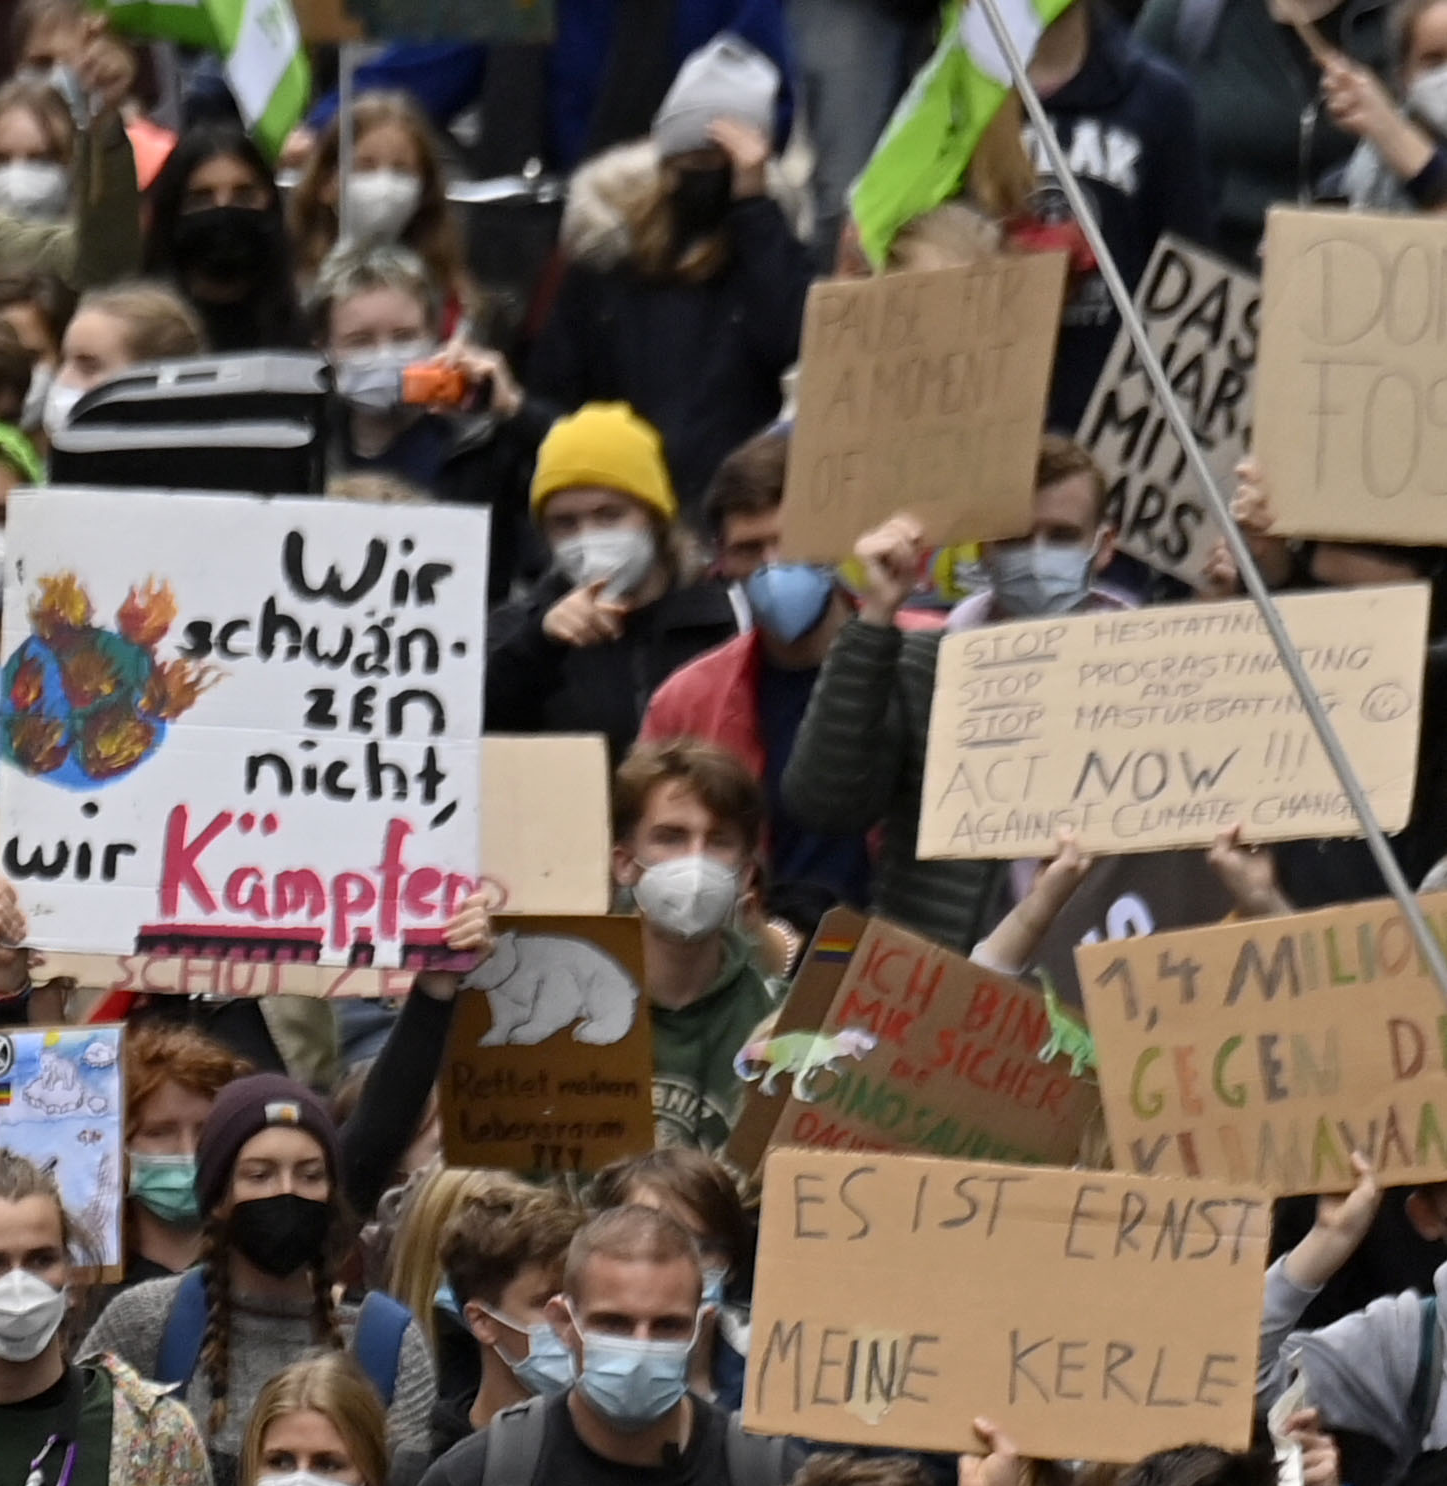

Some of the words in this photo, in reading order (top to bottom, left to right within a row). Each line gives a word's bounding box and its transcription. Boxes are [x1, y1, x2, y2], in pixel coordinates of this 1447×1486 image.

[283, 531, 454, 607] Wir
[962, 626, 1067, 666] STOP
[958, 671, 1042, 704] STOP
[956, 709, 1043, 746] STOP
[936, 752, 1049, 811] ACT
[1071, 745, 1242, 801] NOW
[2, 801, 137, 883] wir
[1110, 799, 1239, 838] CLIMATE
[861, 937, 946, 1016] ICH
[1093, 950, 1203, 1033] 1,4
[1131, 1027, 1342, 1121] GEGEN
[793, 1167, 881, 1241] ES
[910, 1174, 1029, 1239] IST
[1063, 1184, 1264, 1265] ERNST
[755, 1318, 941, 1415] MEINE
[1005, 1326, 1240, 1409] KERLE
